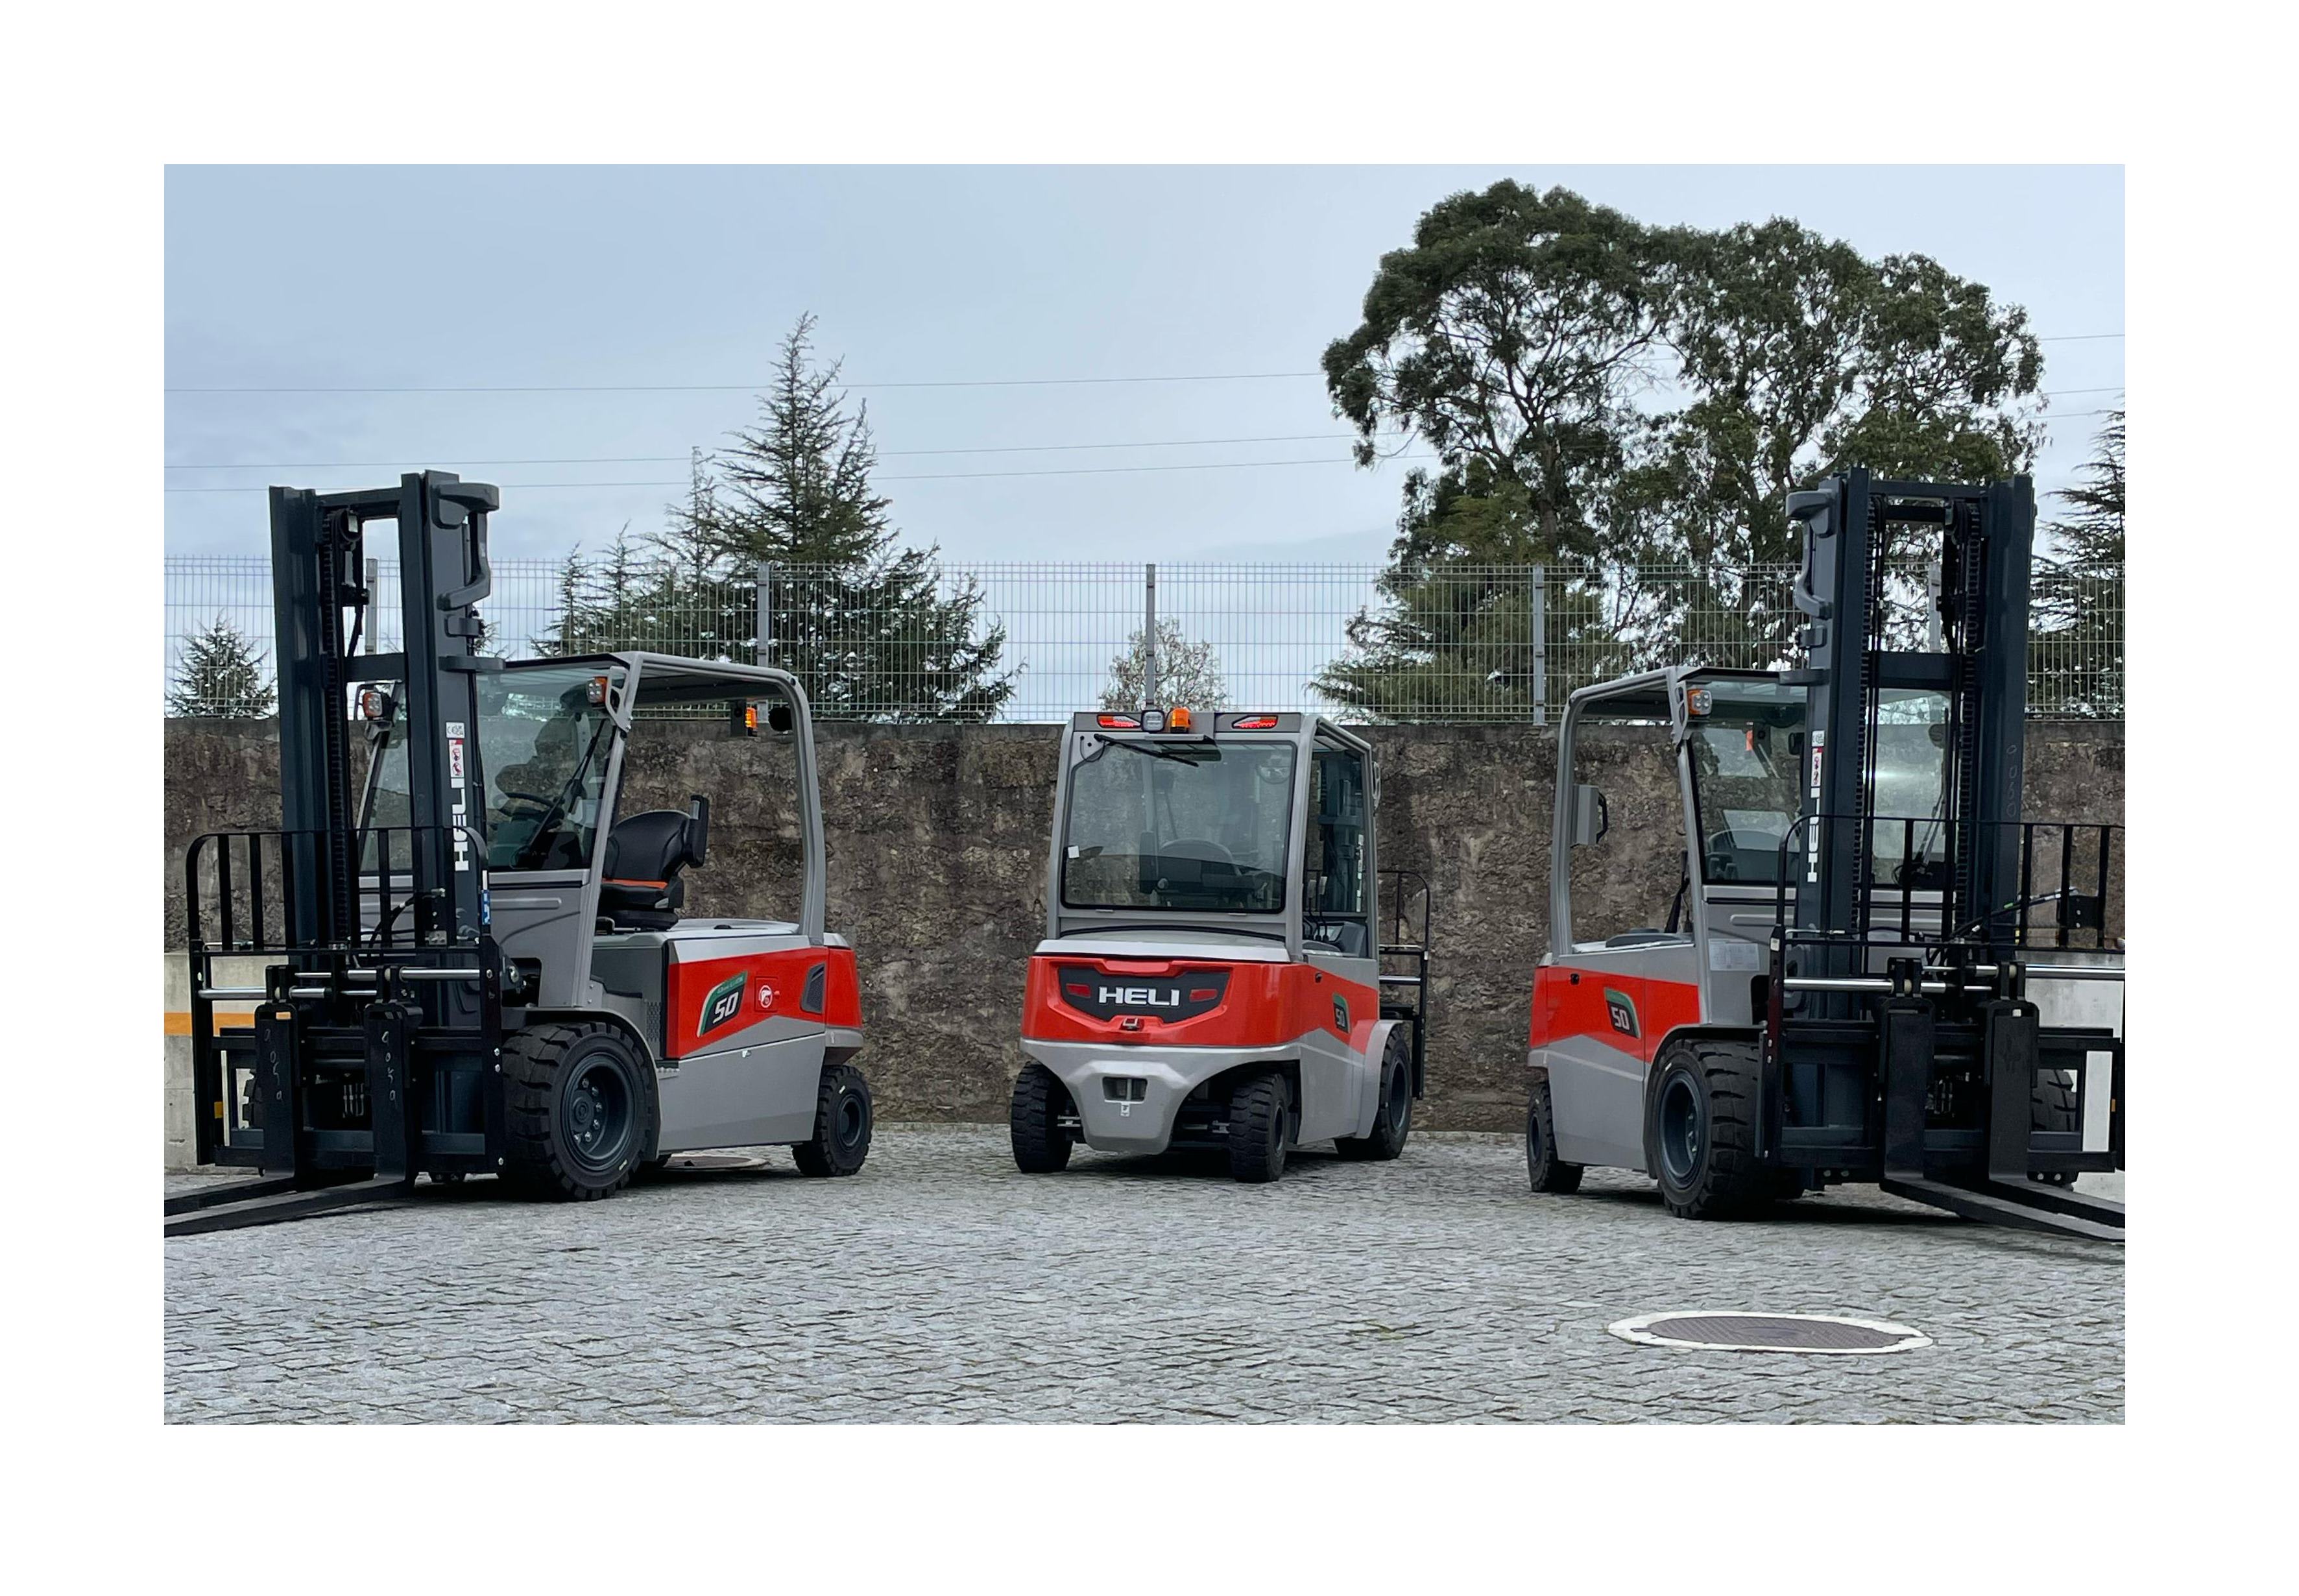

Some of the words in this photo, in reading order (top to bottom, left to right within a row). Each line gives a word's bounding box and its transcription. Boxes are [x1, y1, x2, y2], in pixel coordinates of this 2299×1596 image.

[451, 778, 470, 871] HELI
[1807, 787, 1821, 883] HELI
[712, 991, 740, 1024] 50
[1098, 986, 1180, 1006] HELI
[1335, 1007, 1346, 1027] 50
[1611, 1006, 1630, 1030] 50
